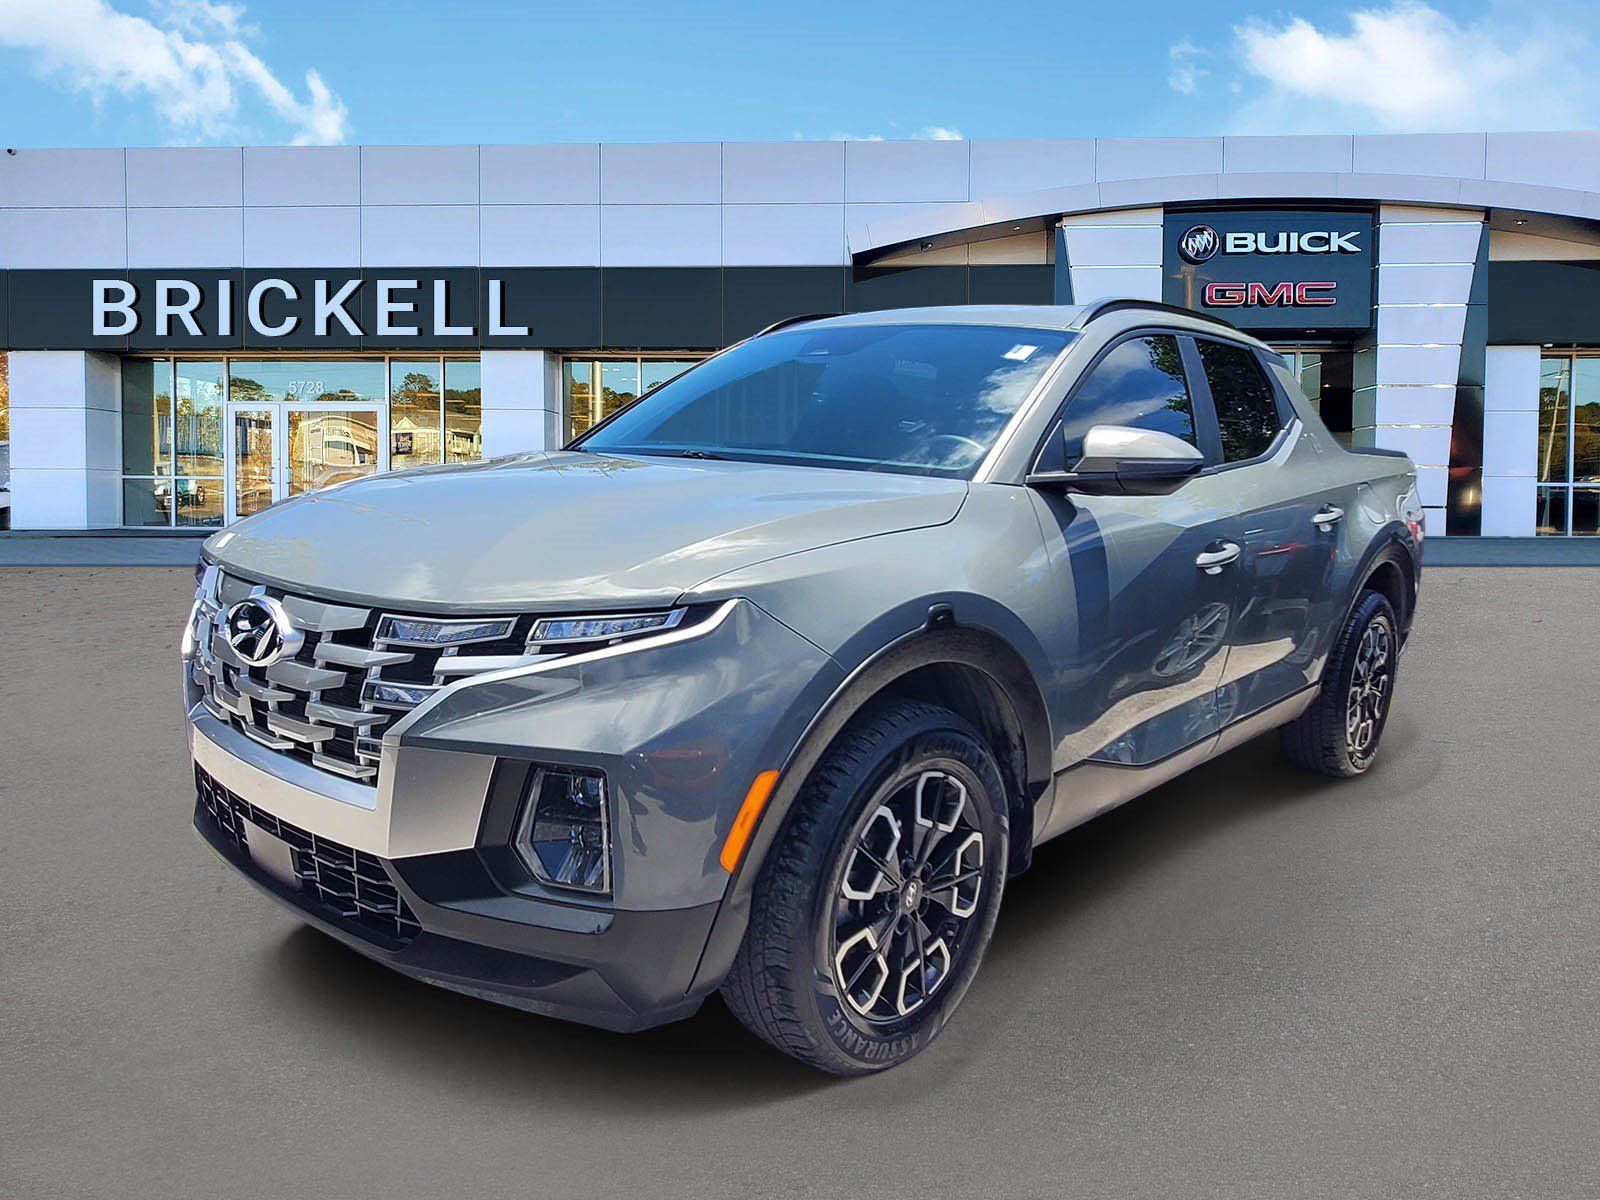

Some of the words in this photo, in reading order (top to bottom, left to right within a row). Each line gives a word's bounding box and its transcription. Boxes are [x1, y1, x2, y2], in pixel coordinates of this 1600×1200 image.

[1225, 231, 1362, 253] BUICK
[1205, 281, 1337, 305] GMC
[92, 278, 530, 337] BRICKELL
[288, 380, 325, 395] 5728
